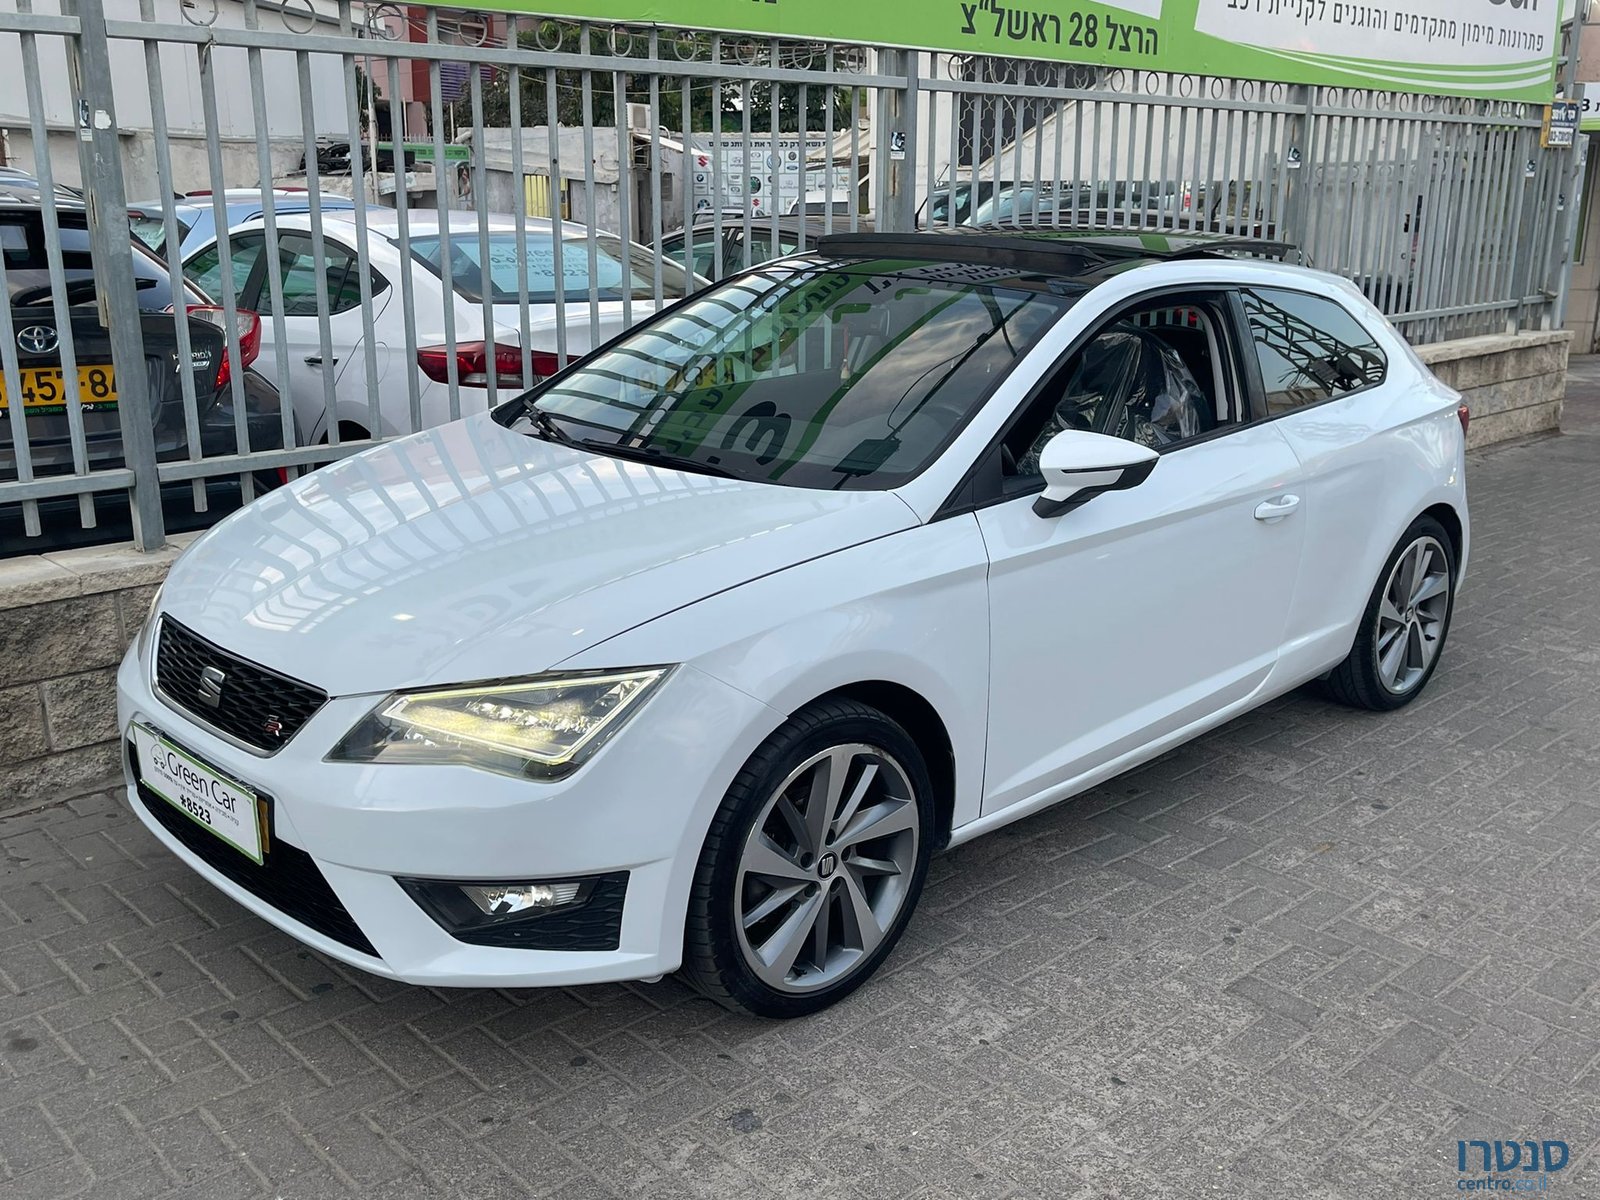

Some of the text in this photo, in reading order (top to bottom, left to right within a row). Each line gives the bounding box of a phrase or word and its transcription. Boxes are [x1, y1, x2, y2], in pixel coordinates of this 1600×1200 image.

[1069, 11, 1098, 49] 28
[1333, 3, 1388, 32] והוגנים
[1393, 18, 1457, 43] מתקדמים
[1105, 14, 1158, 56] הרצל
[1462, 22, 1494, 47] מימון
[1498, 28, 1544, 52] פתרונות
[167, 752, 209, 797] Green
[211, 778, 236, 813] Car
